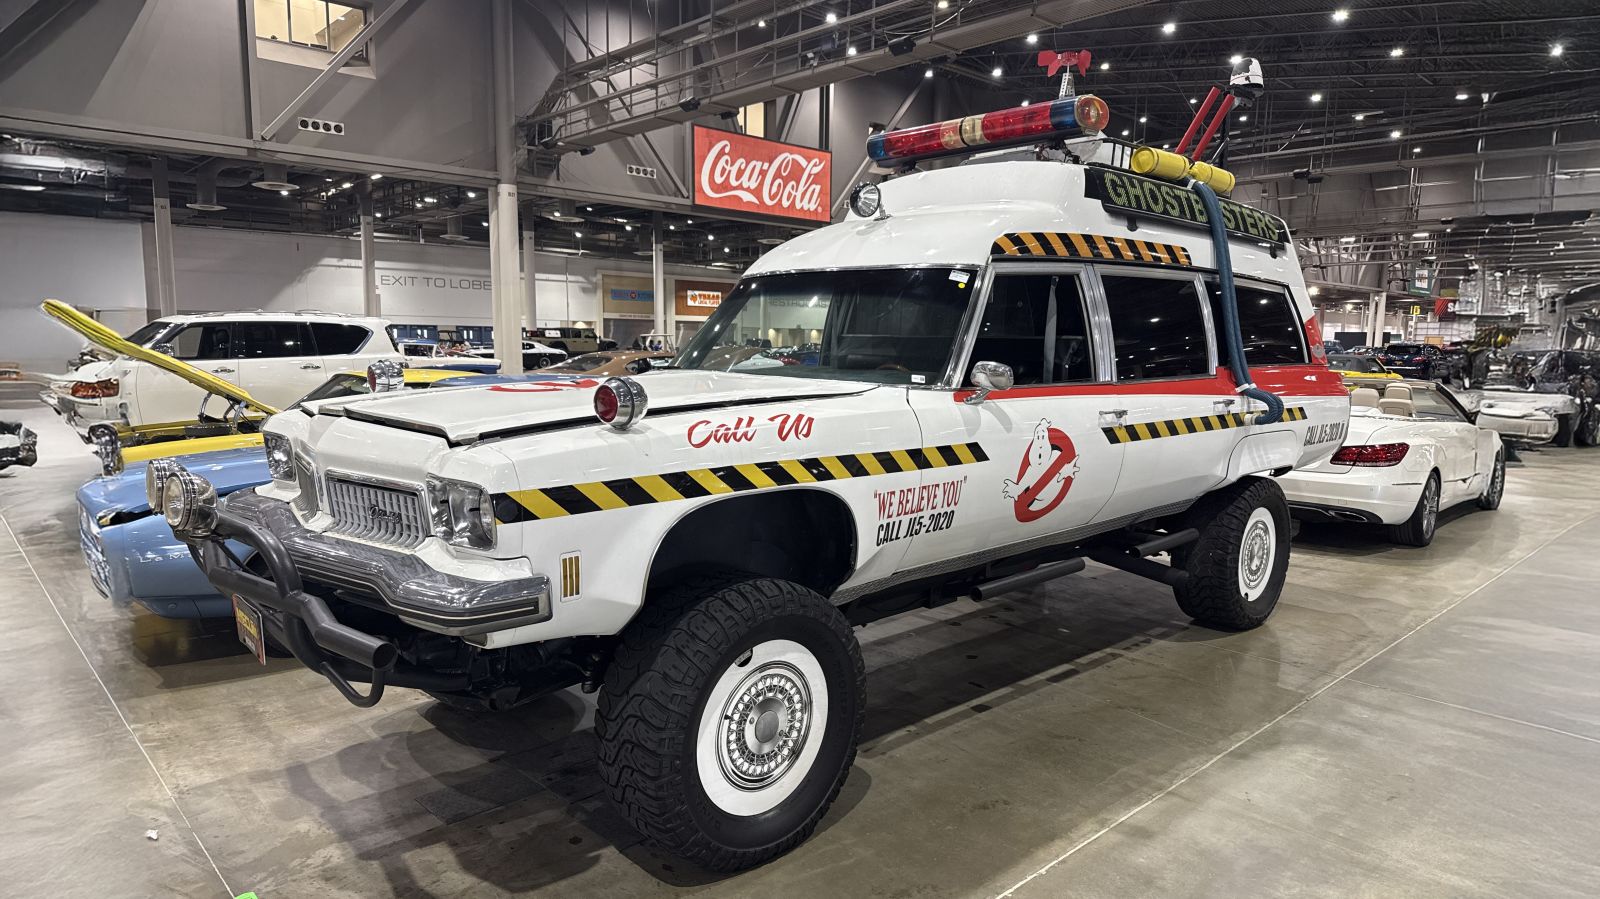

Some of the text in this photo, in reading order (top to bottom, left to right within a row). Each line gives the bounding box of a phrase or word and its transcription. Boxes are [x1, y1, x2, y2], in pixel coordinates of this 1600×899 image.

[701, 140, 826, 212] Coca-Cola
[1104, 172, 1279, 241] GHOSTBSTERS
[380, 274, 418, 288] EXIT
[423, 276, 446, 288] TO
[687, 413, 815, 449] Call Us
[1304, 424, 1319, 447] CALL
[895, 483, 940, 518] BELIEVE
[876, 509, 955, 547] CALL JL5-2020
